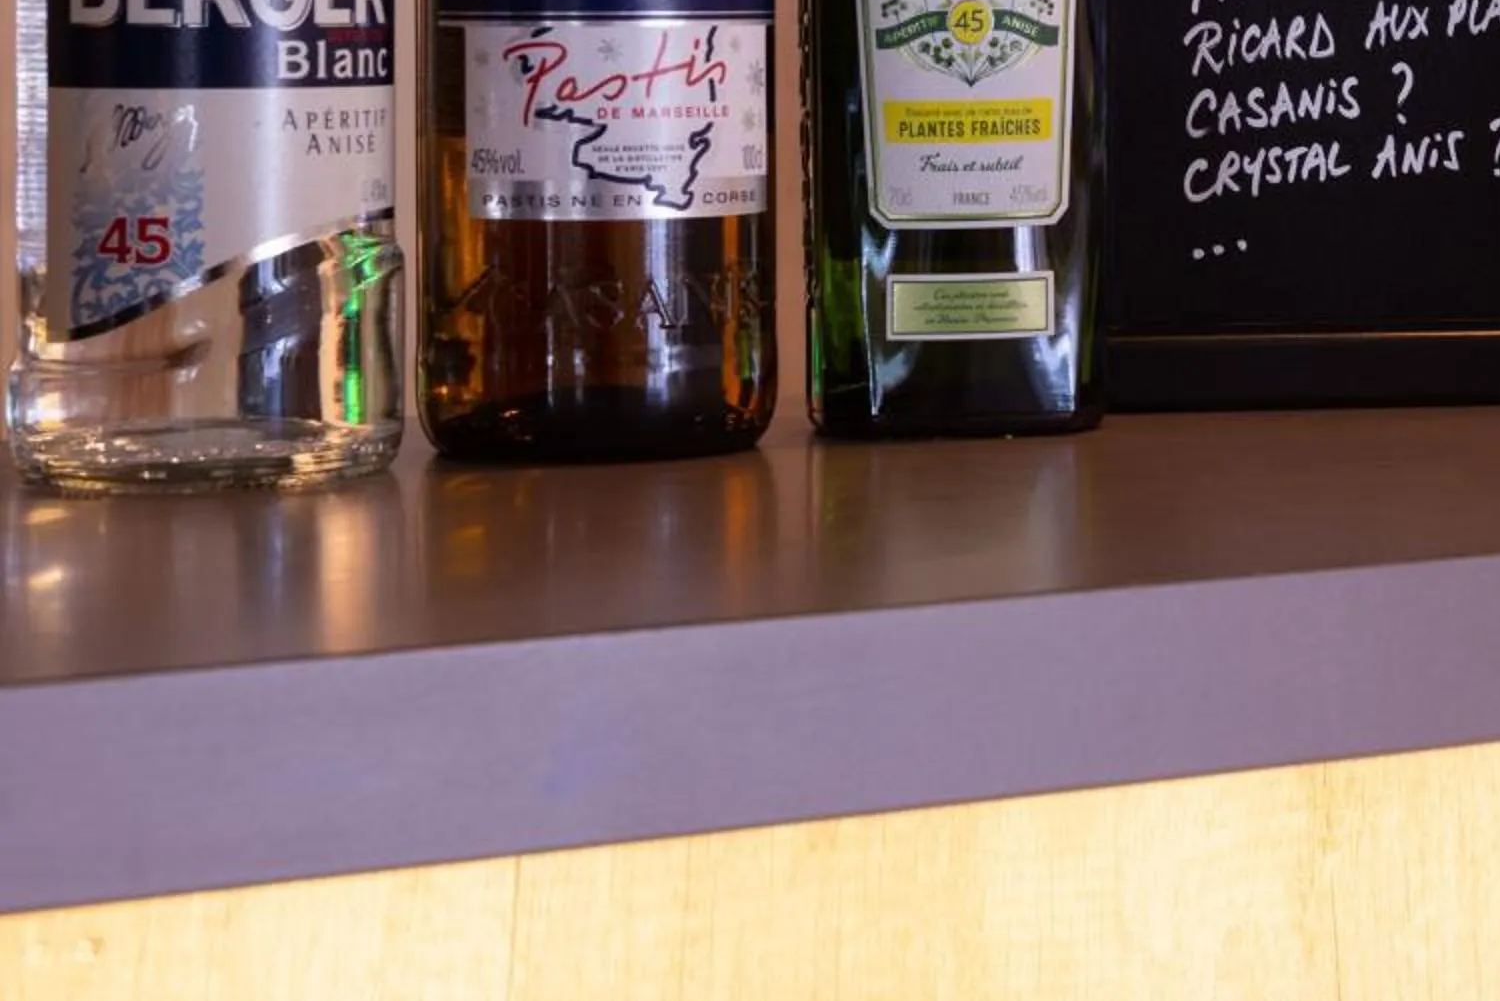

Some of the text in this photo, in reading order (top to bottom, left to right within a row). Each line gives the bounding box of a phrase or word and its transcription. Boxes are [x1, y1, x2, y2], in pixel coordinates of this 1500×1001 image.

[954, 9, 985, 33] 45
[1365, 0, 1429, 50] AUX
[278, 41, 388, 79] Blanc
[503, 30, 726, 127] Pastis
[1391, 61, 1415, 125] ?
[597, 105, 730, 120] DE MARSEILLE
[899, 119, 966, 139] PLANTES
[305, 131, 376, 155] ANISÉ
[1183, 141, 1351, 203] CRYSTAL
[483, 193, 561, 208] PASTIS
[613, 193, 643, 208] EN
[97, 215, 172, 265] 45
